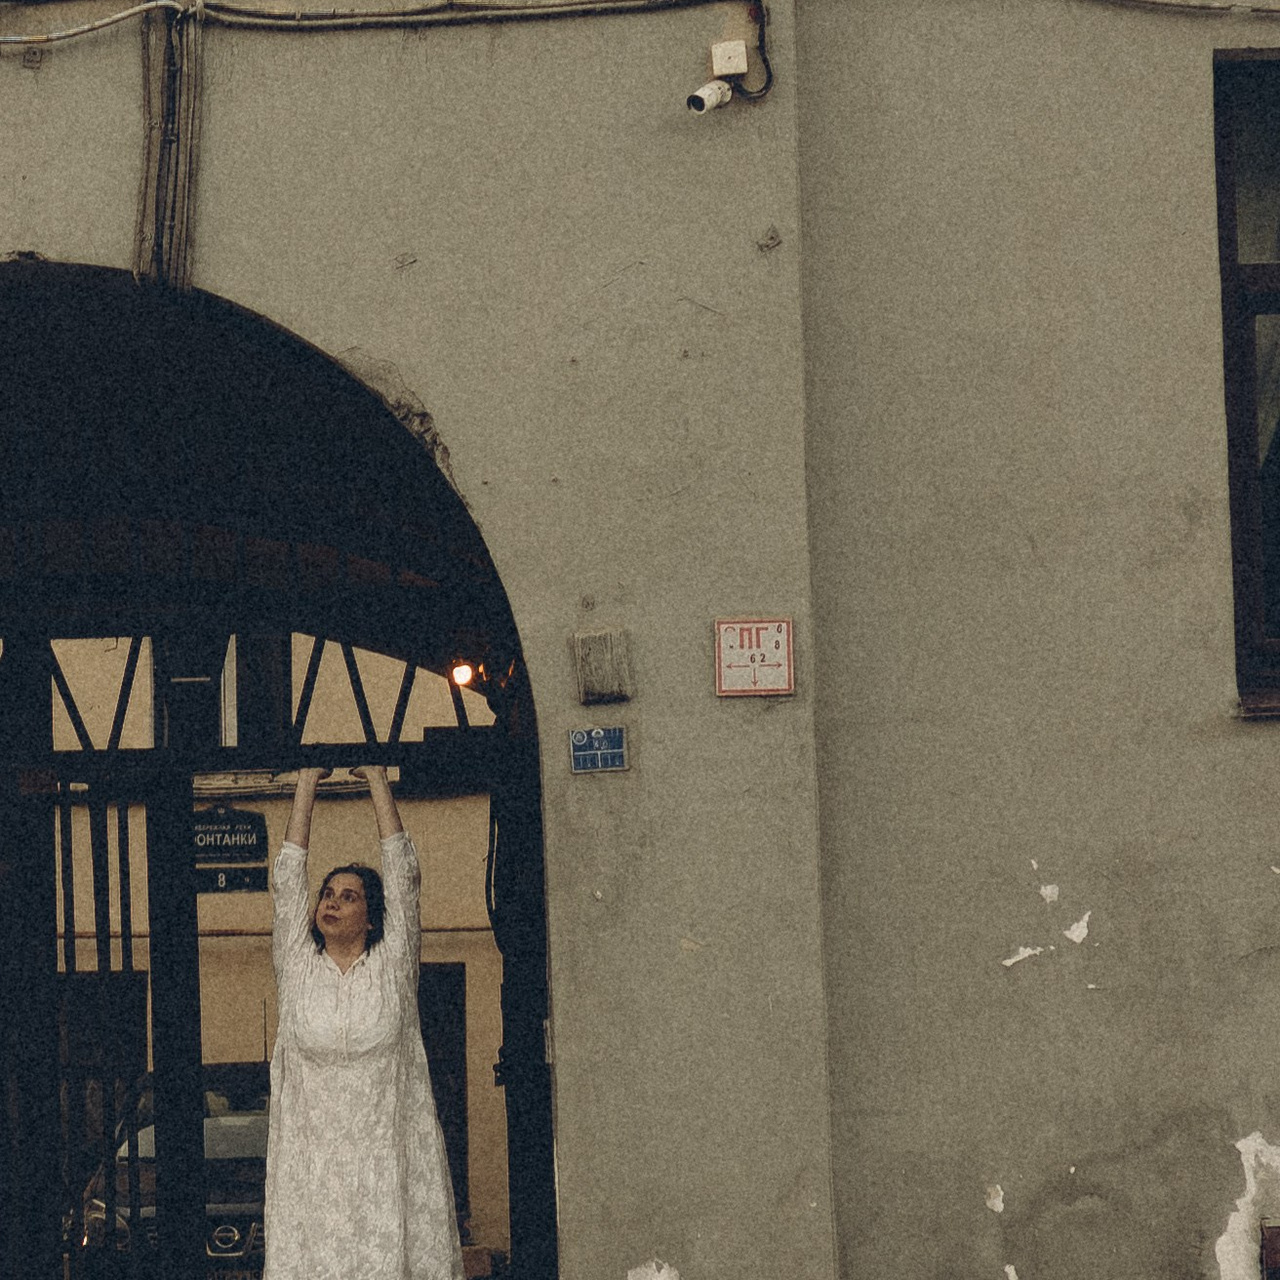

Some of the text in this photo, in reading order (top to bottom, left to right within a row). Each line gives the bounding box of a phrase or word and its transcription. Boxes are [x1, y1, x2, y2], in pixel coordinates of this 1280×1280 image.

[739, 626, 768, 649] ПГ
[774, 640, 780, 650] 8
[194, 833, 256, 846] ОНТАНКИ
[218, 873, 225, 888] 8
